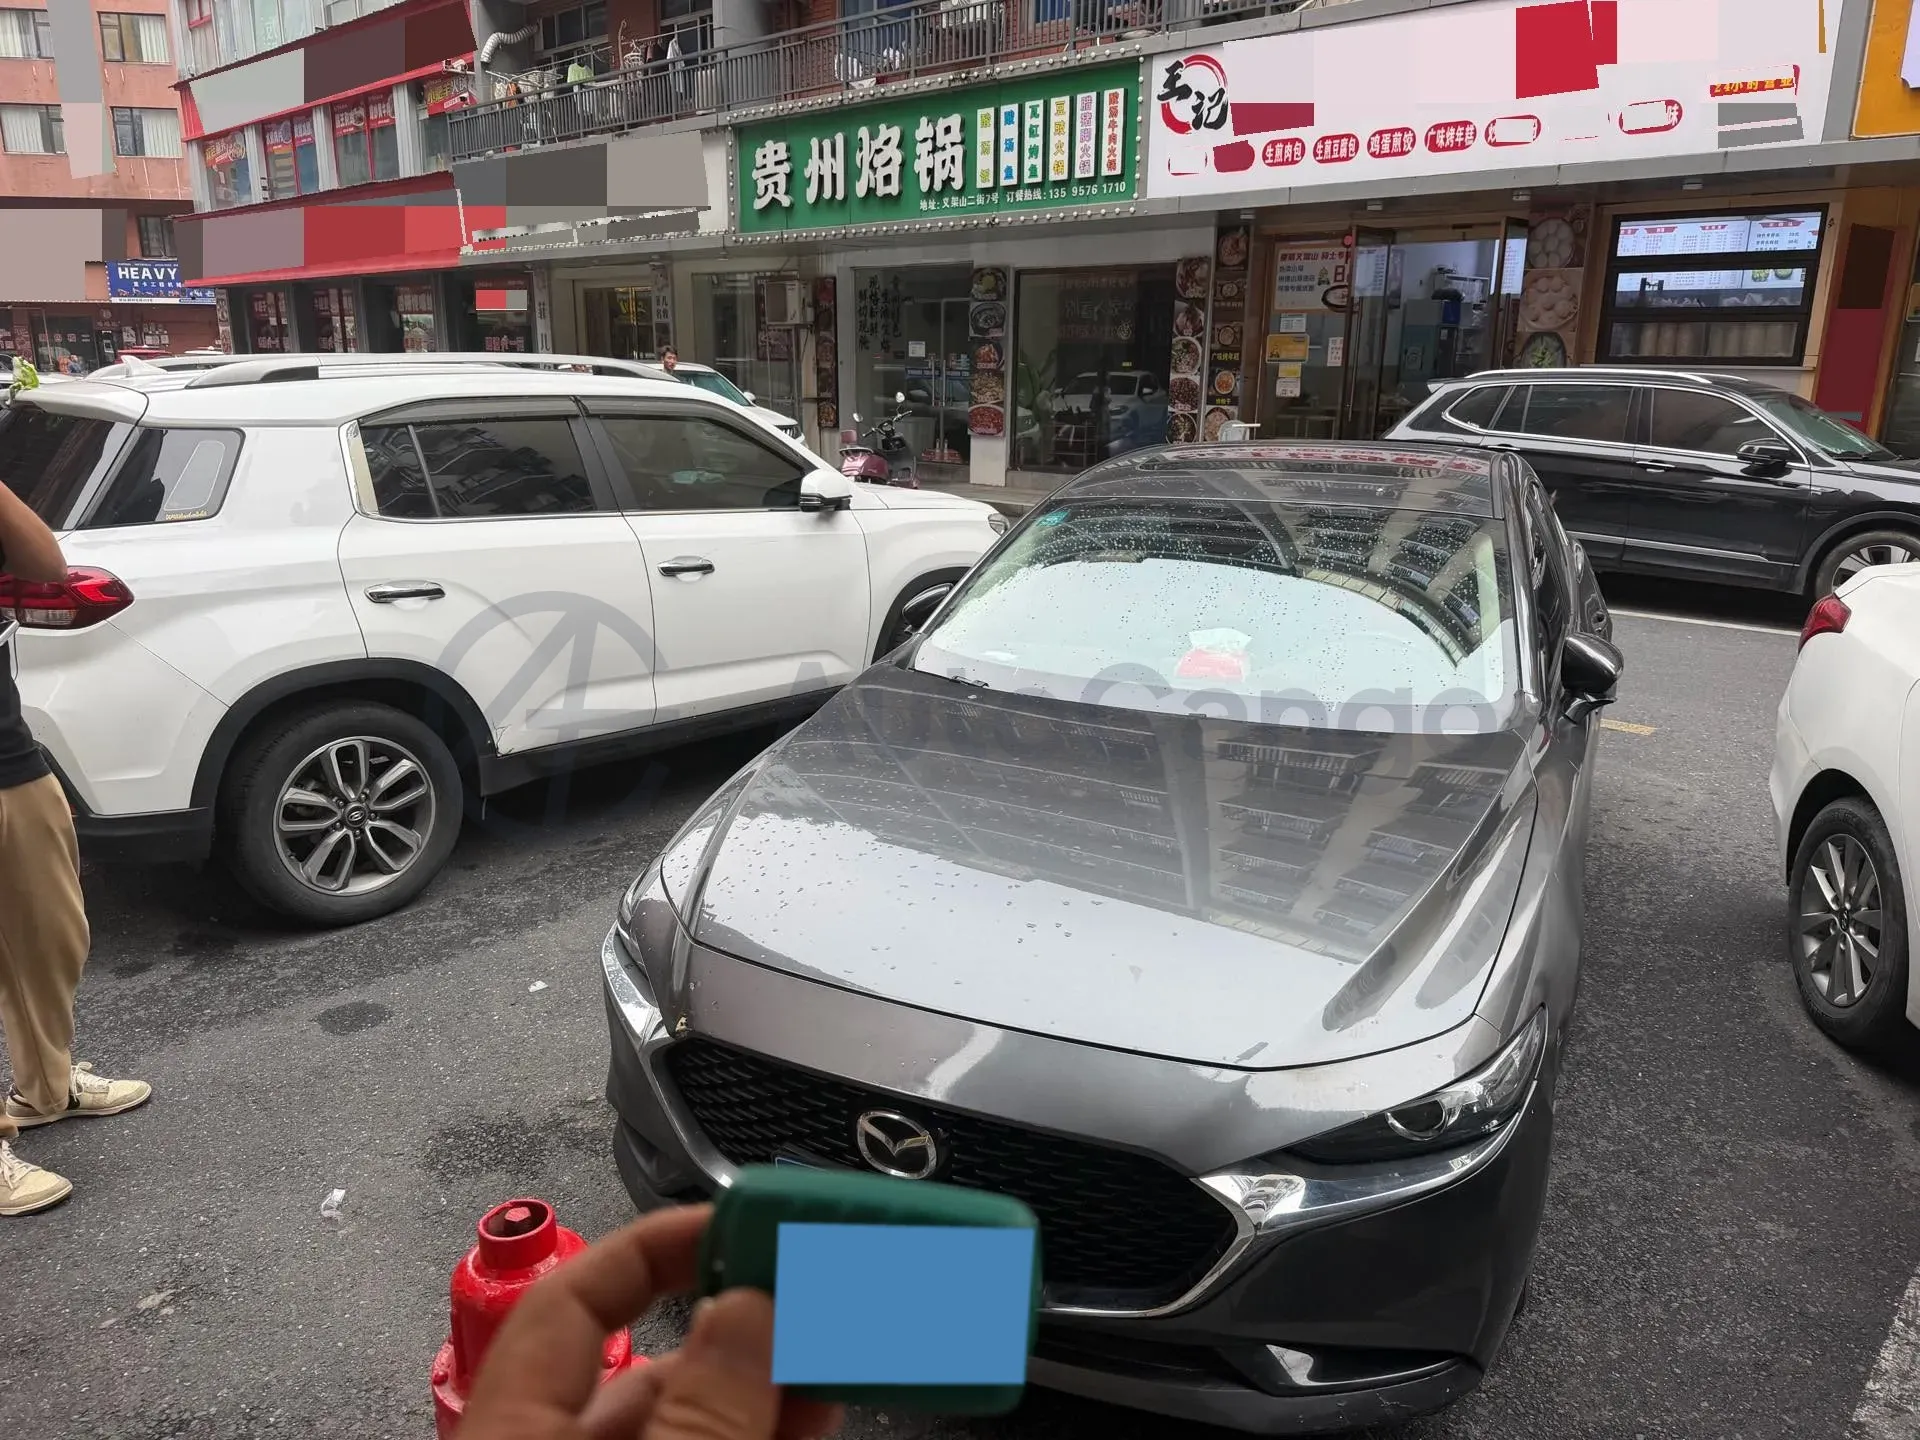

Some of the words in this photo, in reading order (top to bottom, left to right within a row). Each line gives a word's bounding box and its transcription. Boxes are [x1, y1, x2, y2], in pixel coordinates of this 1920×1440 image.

[1157, 60, 1229, 131] 王记
[1106, 90, 1120, 173] 酸汤牛肉火锅
[1427, 124, 1476, 149] 广味烤年糕
[1003, 108, 1015, 181] 酸汤鱼
[1264, 141, 1302, 164] 生煎肉包
[1315, 139, 1356, 161] 生煎豆腐包
[1369, 133, 1414, 157] 鸡蛋煎饺
[752, 113, 964, 210] 贵州烙锅
[1071, 183, 1098, 196] 9576
[1102, 181, 1126, 194] 1710
[117, 266, 178, 280] HEAVY
